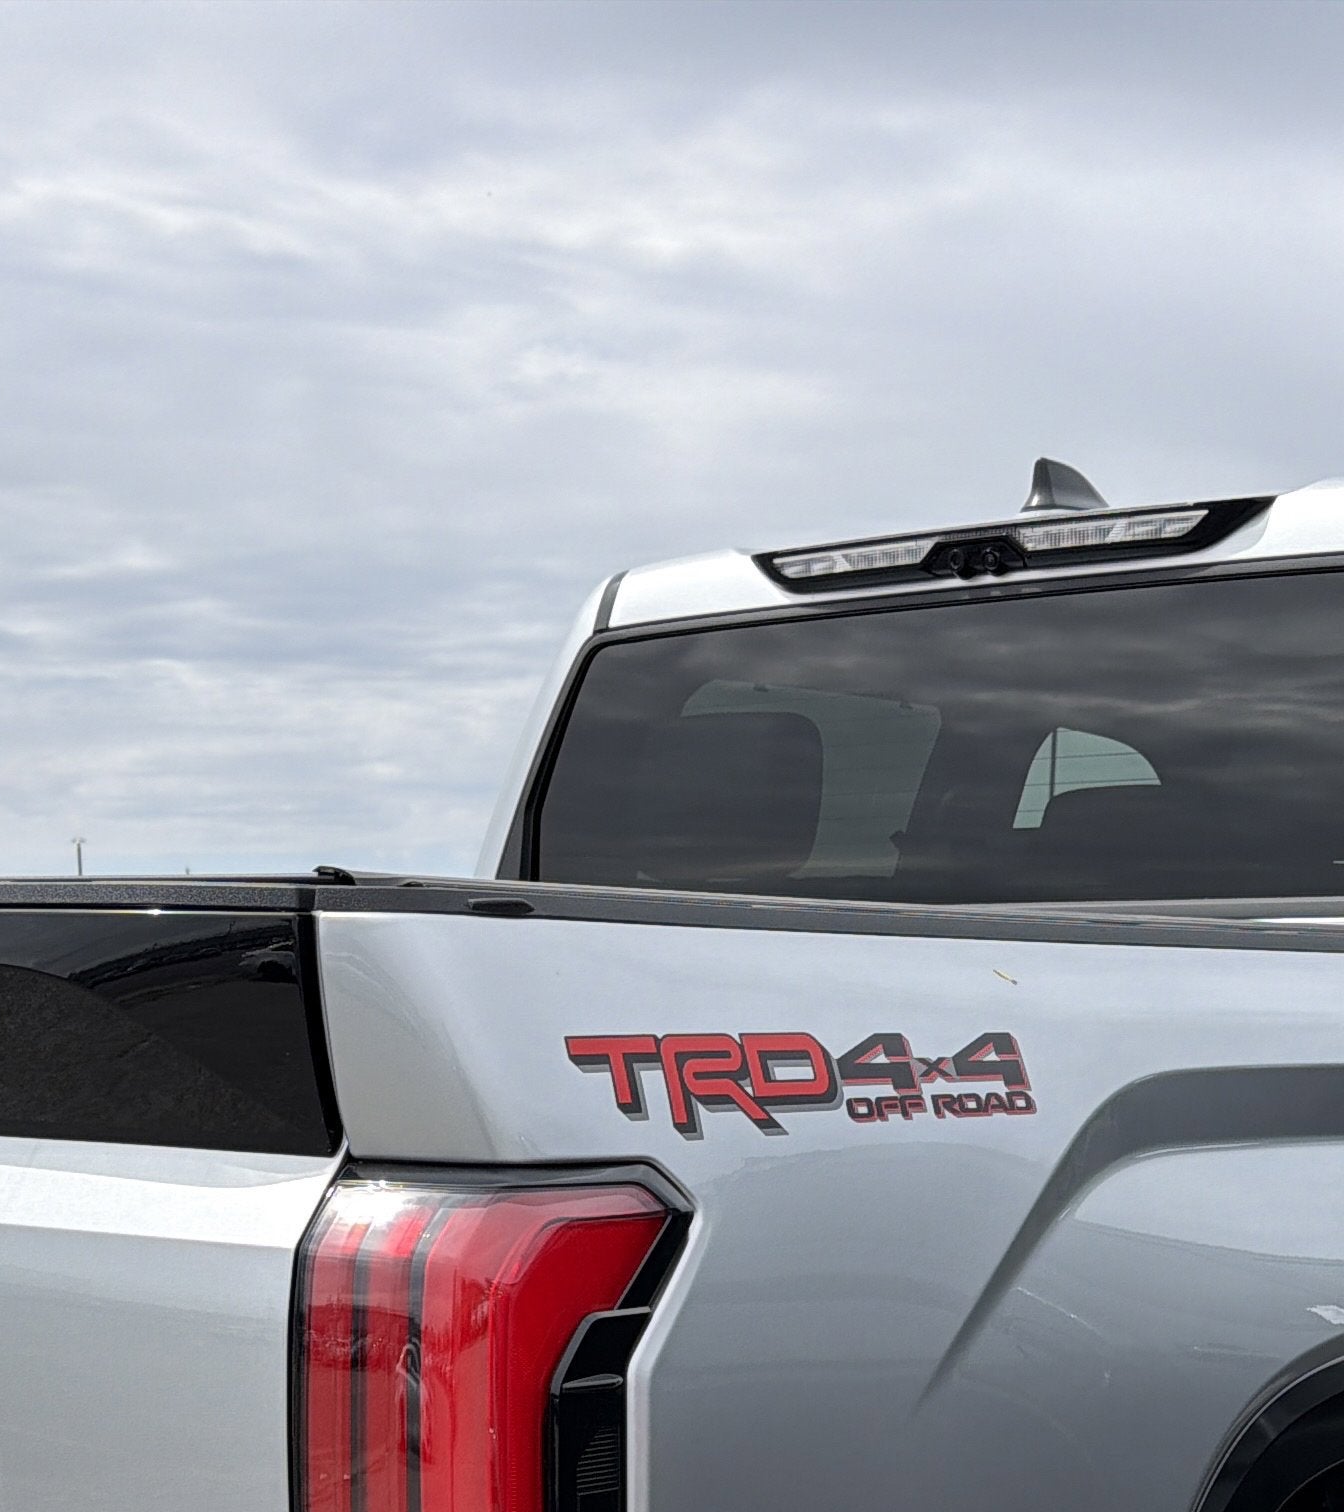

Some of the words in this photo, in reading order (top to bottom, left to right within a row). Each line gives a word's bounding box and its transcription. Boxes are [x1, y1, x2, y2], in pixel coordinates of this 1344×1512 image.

[564, 1032, 844, 1141] TRD
[836, 1032, 1032, 1096] 4x4
[845, 1092, 929, 1123] OFF
[931, 1090, 1038, 1122] ROAD
